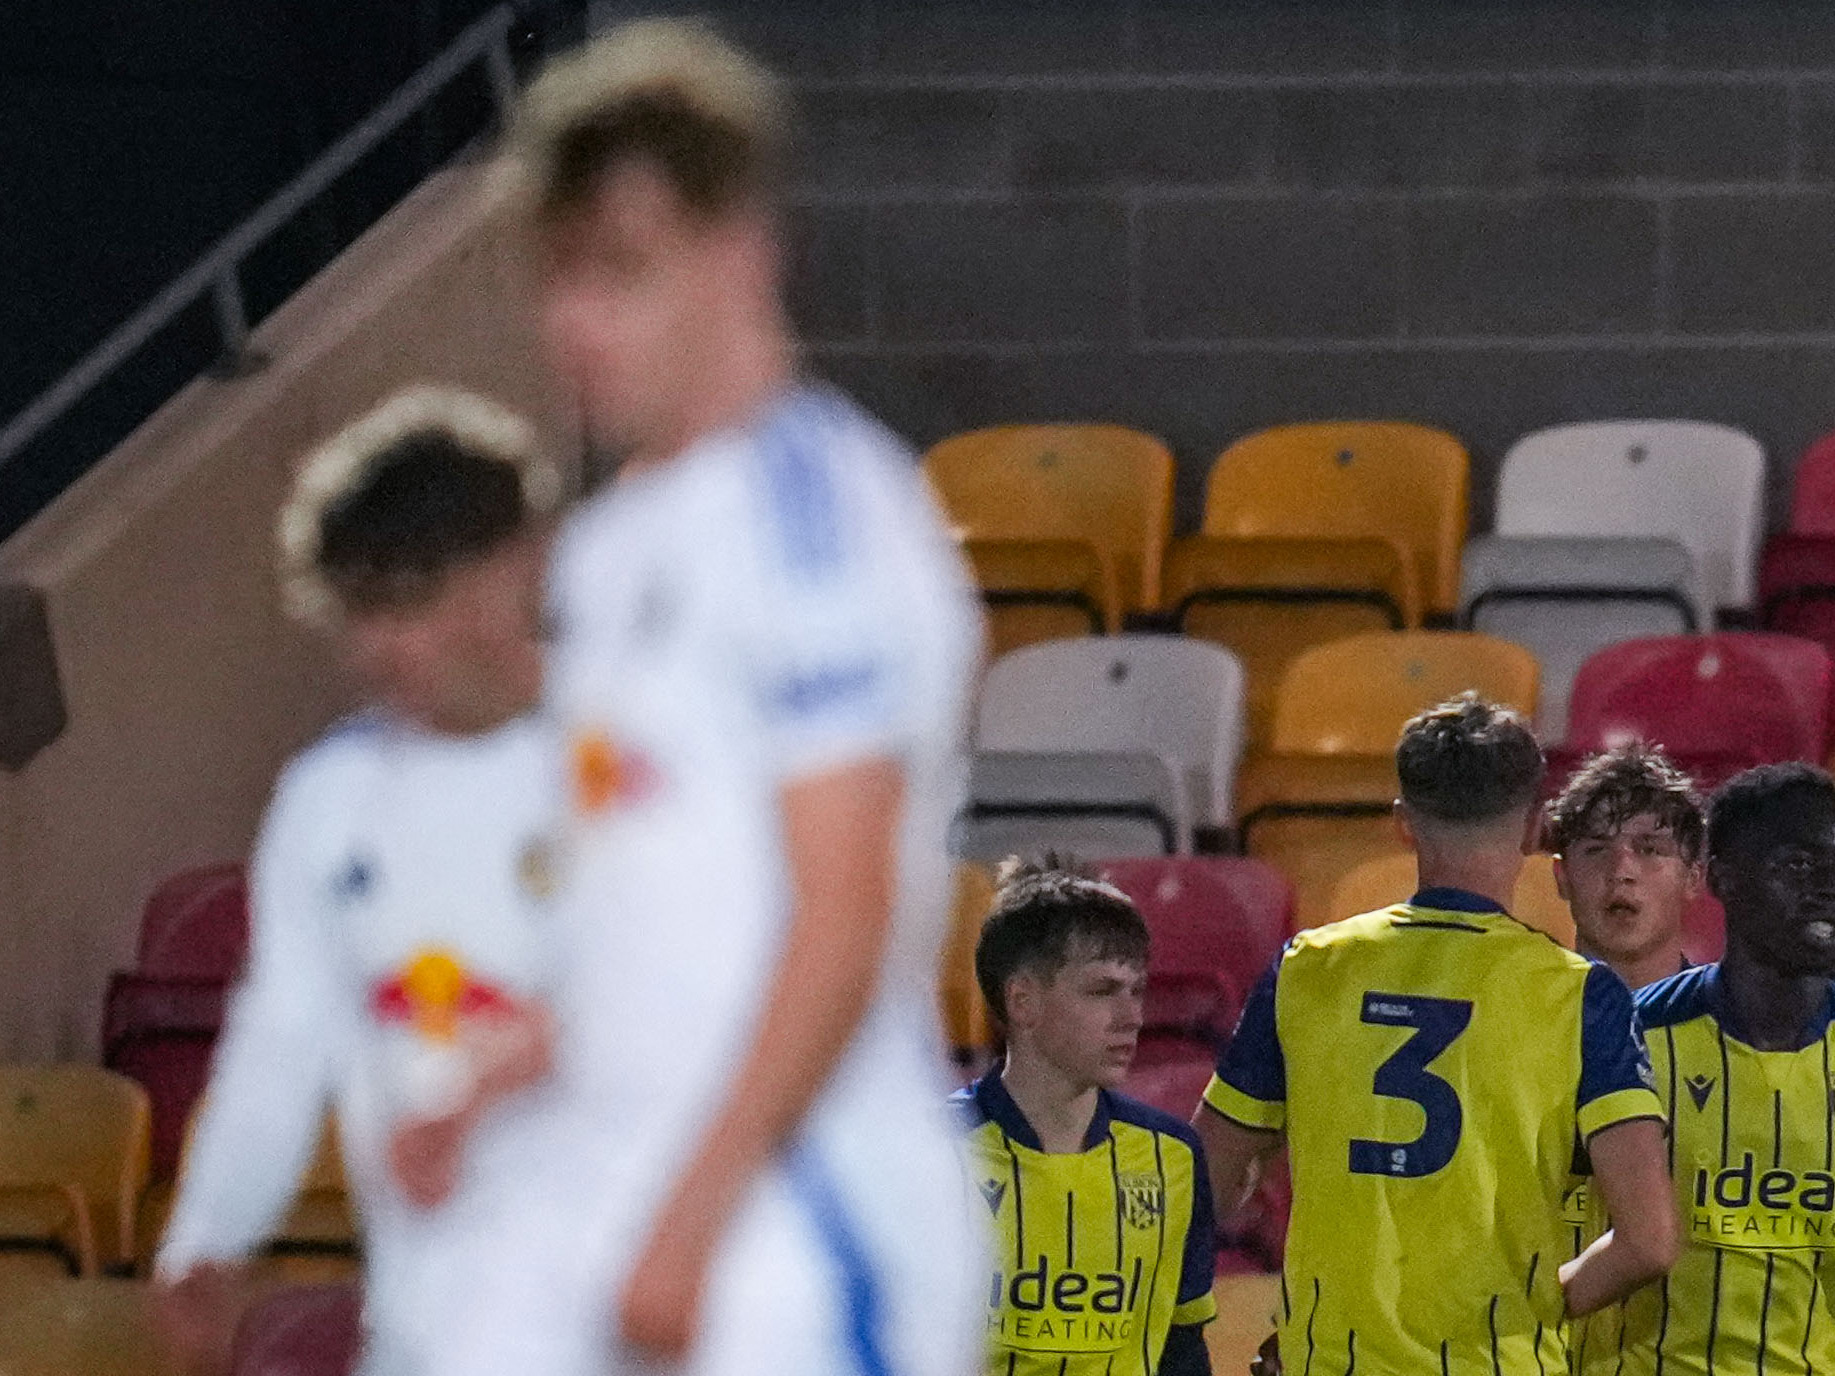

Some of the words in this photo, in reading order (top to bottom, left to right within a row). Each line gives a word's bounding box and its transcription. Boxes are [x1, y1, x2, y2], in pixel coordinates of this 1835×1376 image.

[1349, 990, 1475, 1177] 3
[989, 1254, 1142, 1314] ideal
[987, 1314, 1132, 1342] HEATING
